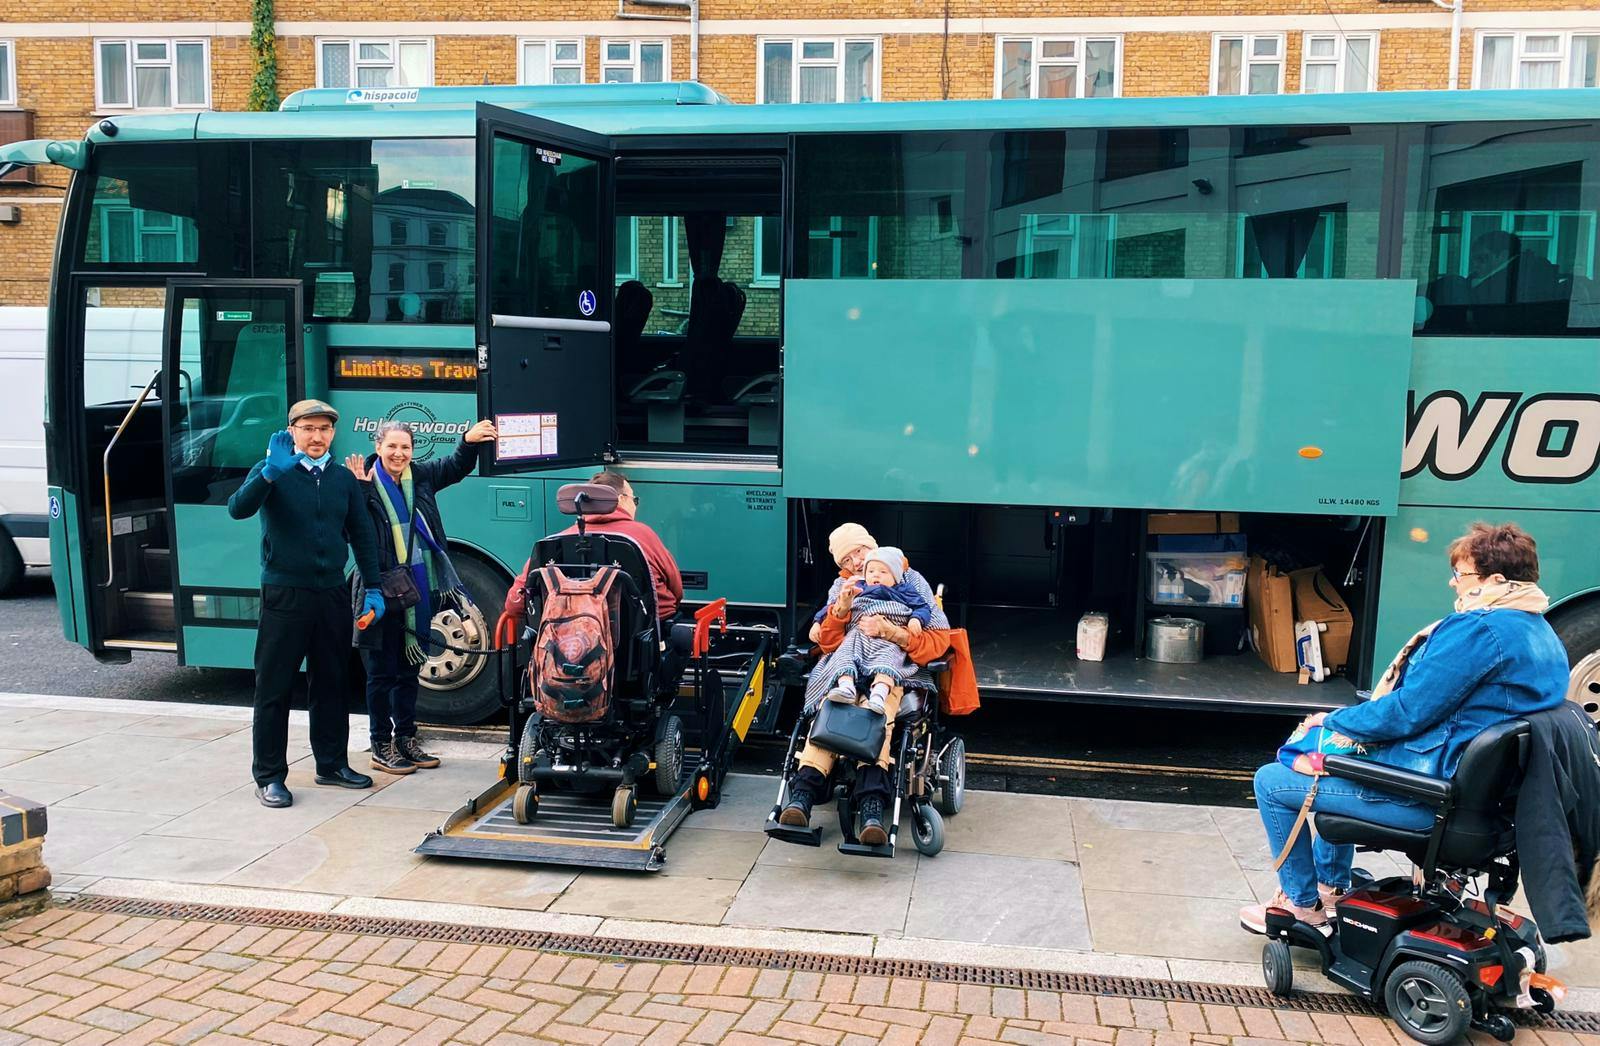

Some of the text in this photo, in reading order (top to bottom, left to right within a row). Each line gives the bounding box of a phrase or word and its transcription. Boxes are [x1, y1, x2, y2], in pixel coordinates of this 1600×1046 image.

[364, 90, 417, 101] hispacold
[340, 359, 423, 377] Limitless
[353, 417, 470, 434] Holswood
[430, 435, 456, 443] Group
